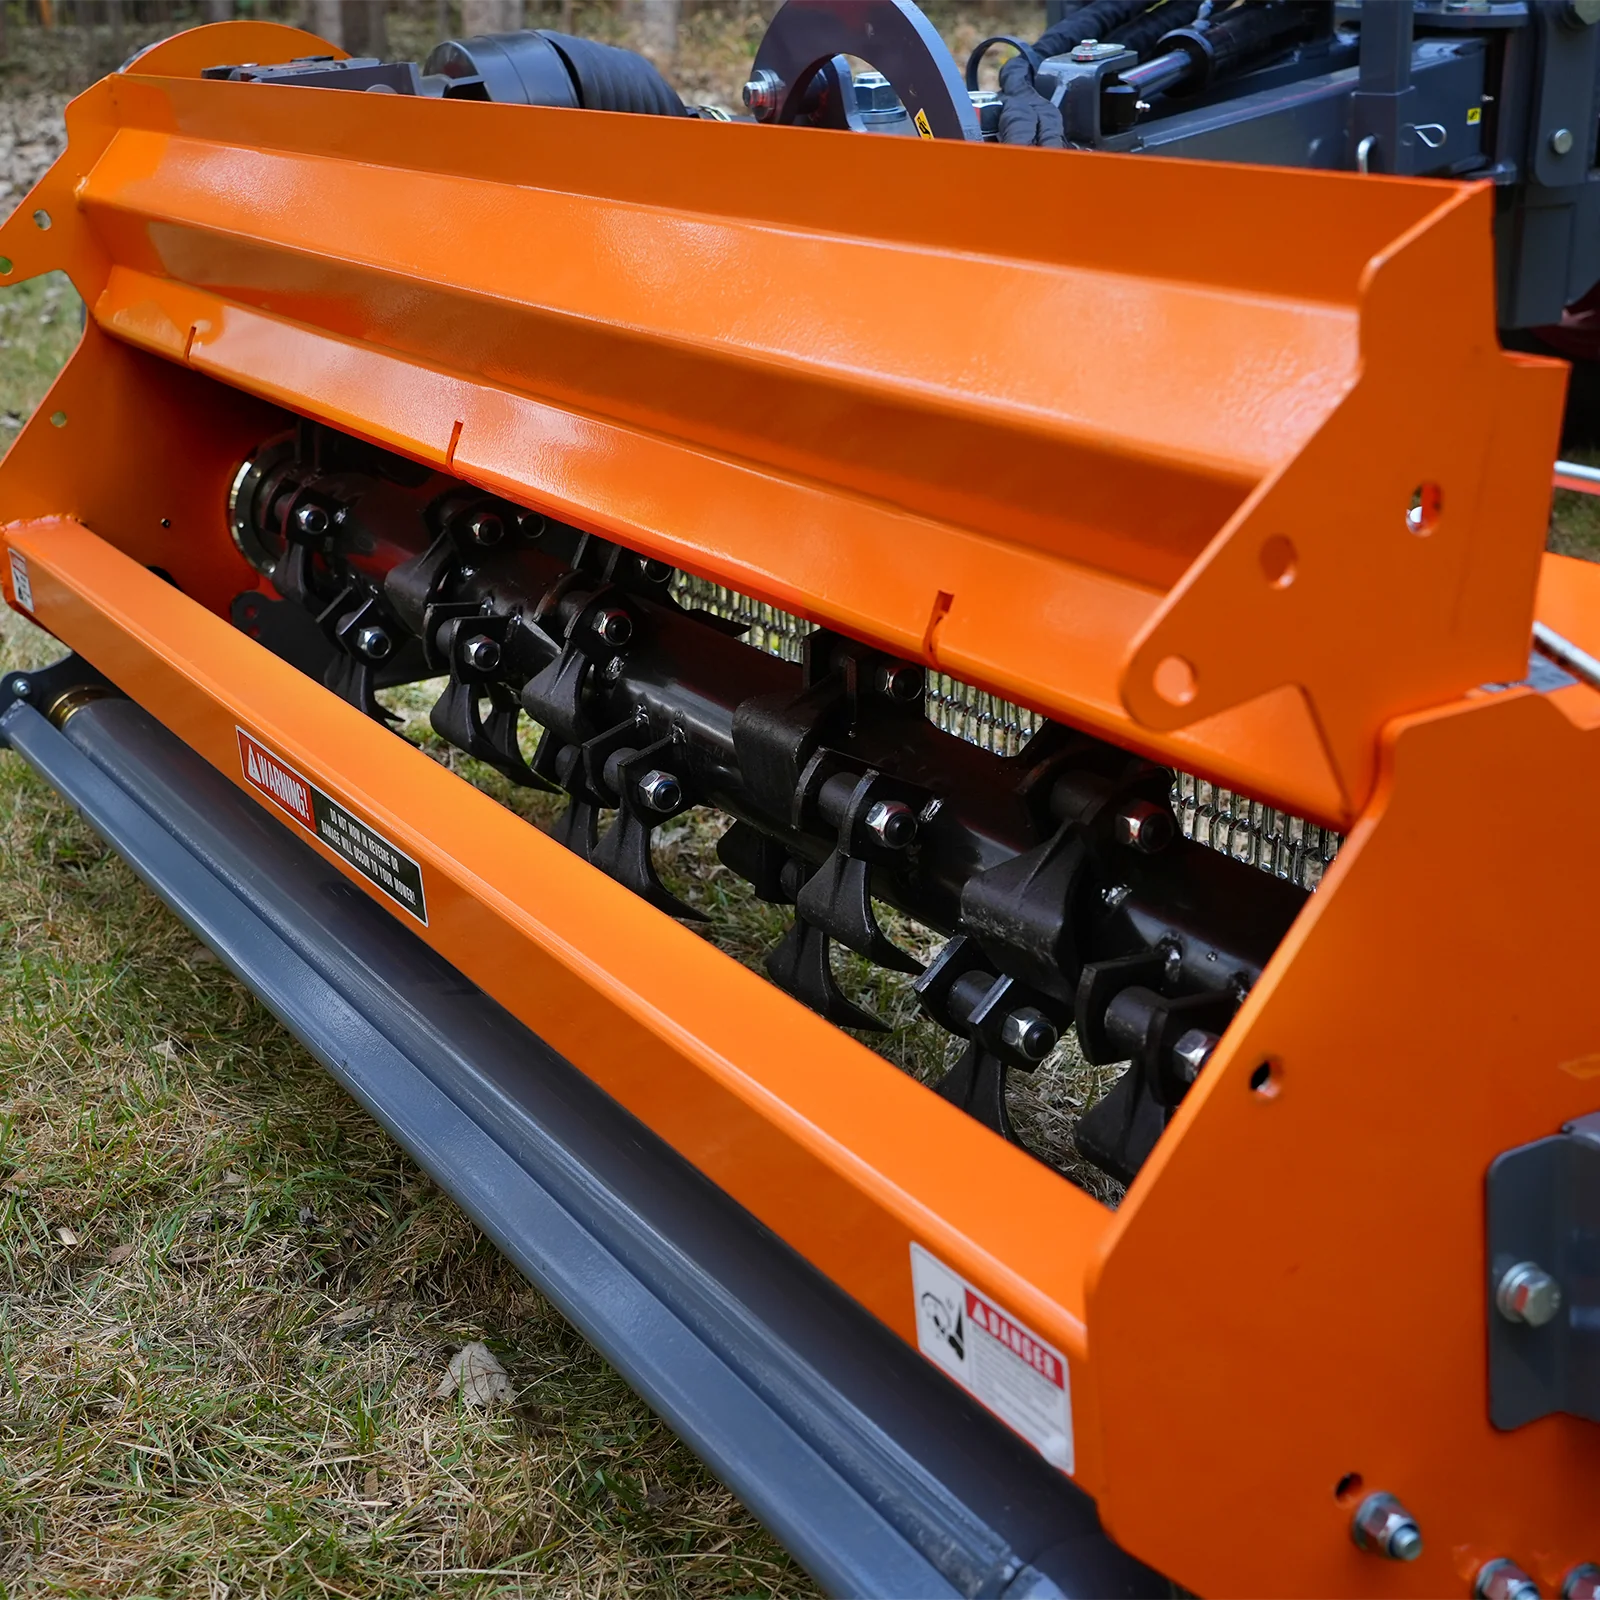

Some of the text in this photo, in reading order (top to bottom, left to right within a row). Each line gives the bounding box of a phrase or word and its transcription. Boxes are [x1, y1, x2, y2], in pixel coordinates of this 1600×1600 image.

[257, 752, 310, 821] WARNING!
[321, 820, 341, 846] DAMAGE
[341, 835, 354, 856] WILL
[354, 845, 371, 870] OCCUR
[371, 859, 379, 876] TO
[379, 865, 394, 888] YOUR
[330, 808, 338, 824] DO
[338, 814, 347, 832] NOT
[348, 822, 361, 843] MOW
[361, 832, 368, 849] IN
[391, 854, 400, 873] OR
[988, 1310, 1056, 1380] DANGER
